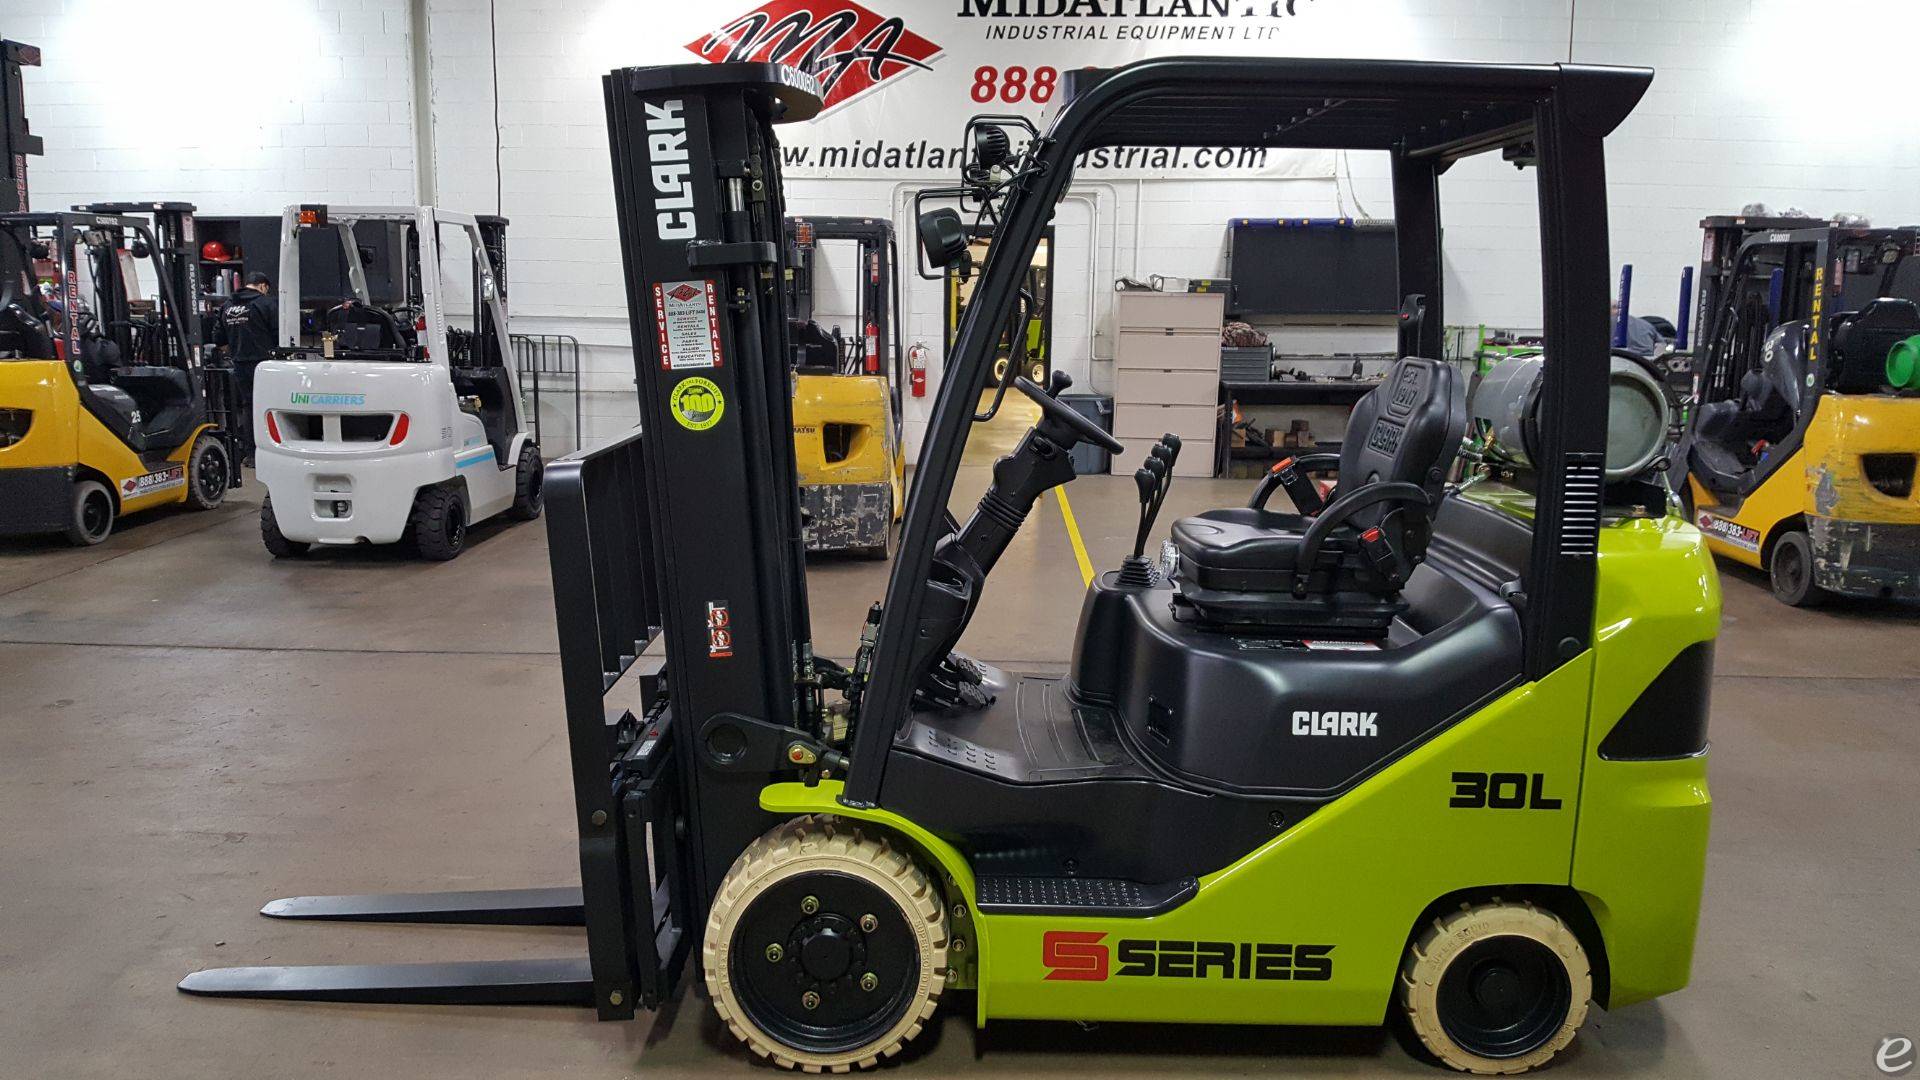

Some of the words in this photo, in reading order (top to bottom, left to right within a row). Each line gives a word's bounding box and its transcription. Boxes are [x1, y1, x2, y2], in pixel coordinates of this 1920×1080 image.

[985, 25, 1108, 40] INDUSTRIAL
[1116, 26, 1236, 40] EQUIPMENT
[645, 100, 697, 240] CLARK
[67, 270, 81, 355] RENTAL
[190, 263, 198, 315] KOMATSU
[1809, 267, 1825, 361] RENTAL
[654, 286, 670, 365] SERVICE
[706, 283, 721, 362] RENTALS
[131, 410, 141, 423] 25
[1292, 711, 1378, 737] CLARK
[1449, 772, 1562, 809] 30L
[1042, 930, 1110, 982] S
[1115, 939, 1337, 981] SERIES
